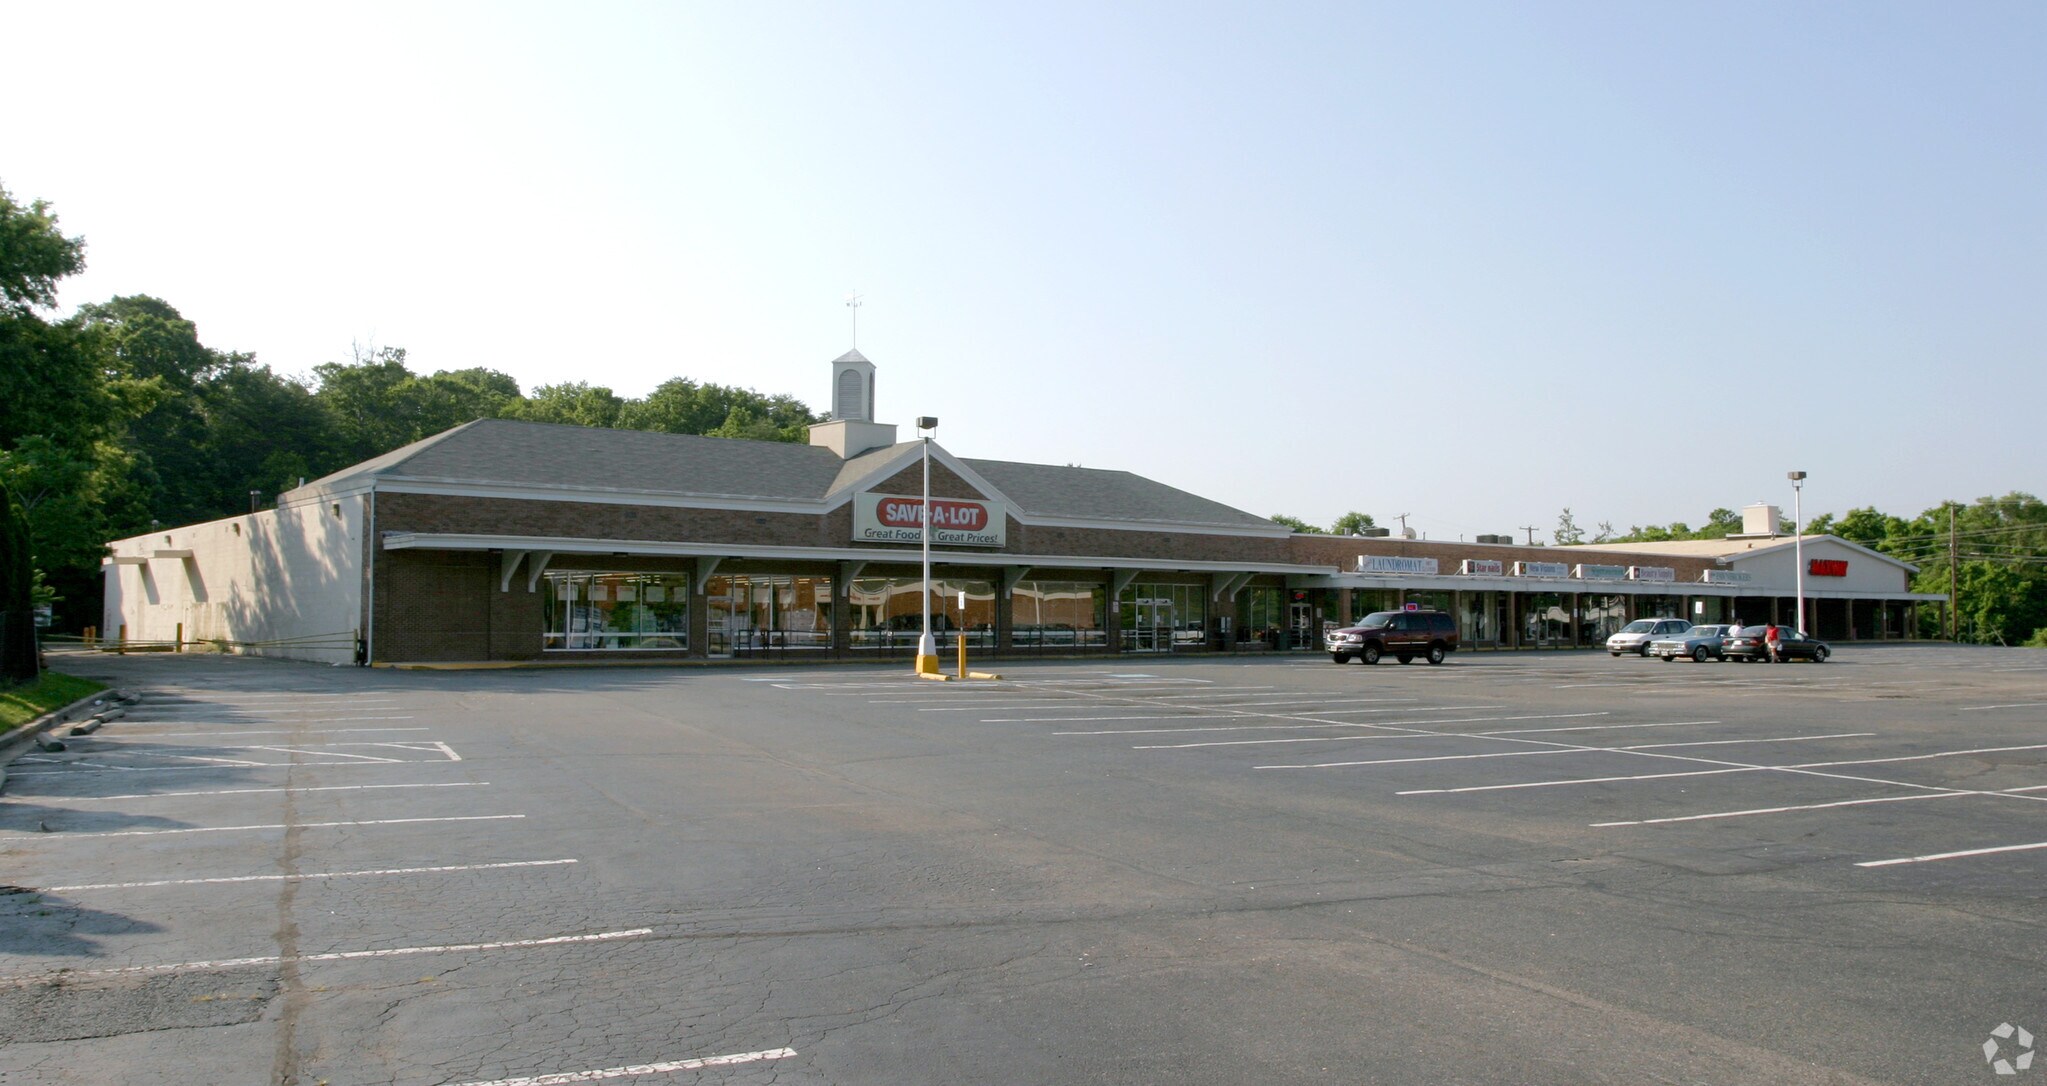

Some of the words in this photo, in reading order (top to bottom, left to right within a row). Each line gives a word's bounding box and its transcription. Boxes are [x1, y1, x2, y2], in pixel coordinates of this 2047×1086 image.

[864, 528, 892, 539] Great
[896, 529, 921, 539] Food
[938, 532, 964, 541] Great
[967, 533, 998, 543] Prices!
[1372, 558, 1422, 572] LAUNDROMAT
